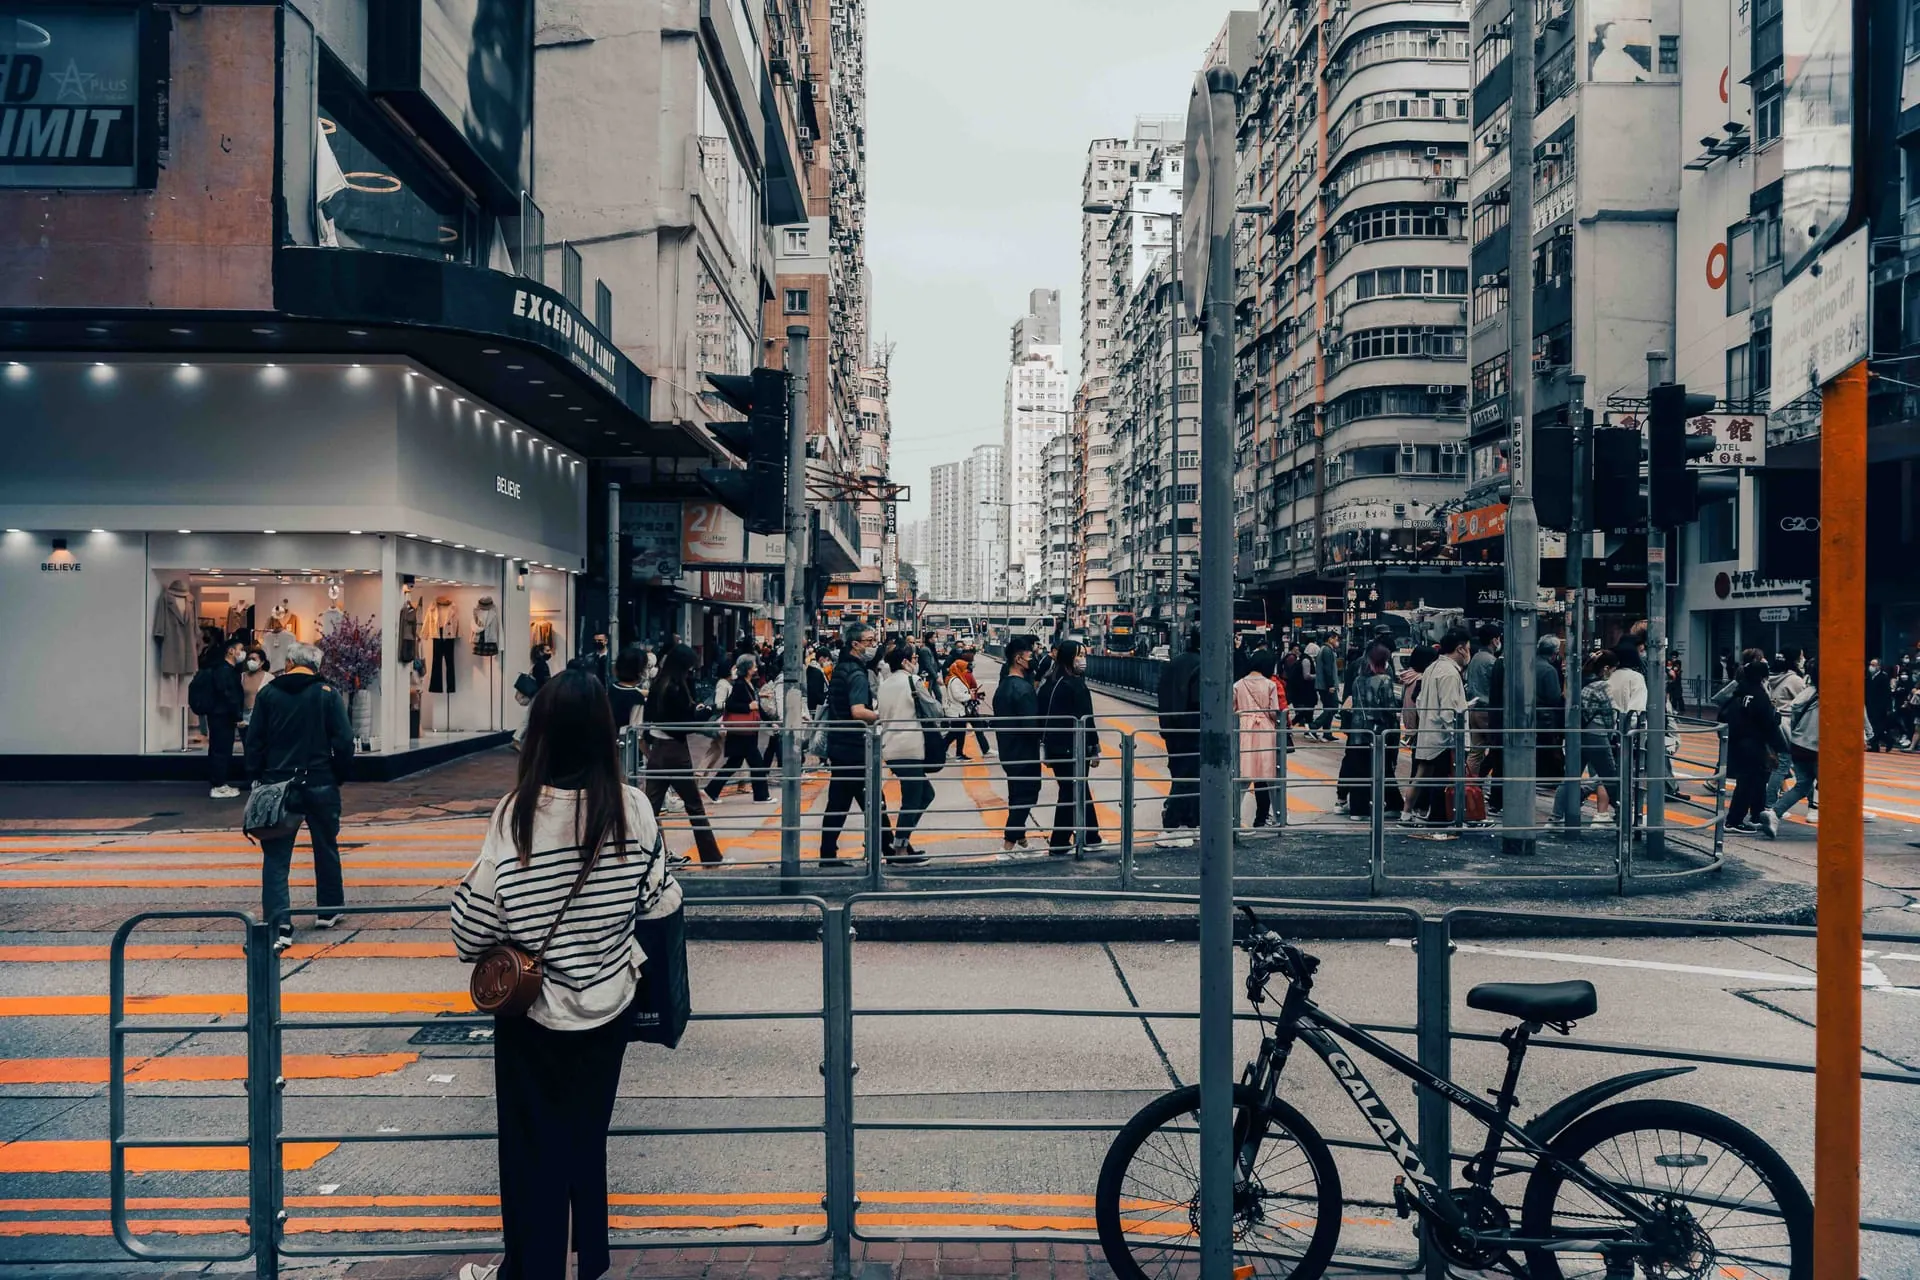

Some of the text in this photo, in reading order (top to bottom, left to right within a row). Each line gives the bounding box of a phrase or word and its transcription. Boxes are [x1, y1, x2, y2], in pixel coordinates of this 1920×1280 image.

[0, 54, 43, 102] D
[91, 79, 128, 91] PLUS
[1824, 255, 1843, 290] taxi
[1839, 276, 1855, 309] off
[513, 290, 573, 338] EXCEED
[574, 321, 594, 359] YOUR
[596, 341, 616, 376] LIMIT
[496, 475, 521, 500] BELIEVE
[41, 563, 81, 571] BELIEVE
[1328, 1052, 1438, 1186] GALAXY
[1417, 1183, 1437, 1203] CYCLE
